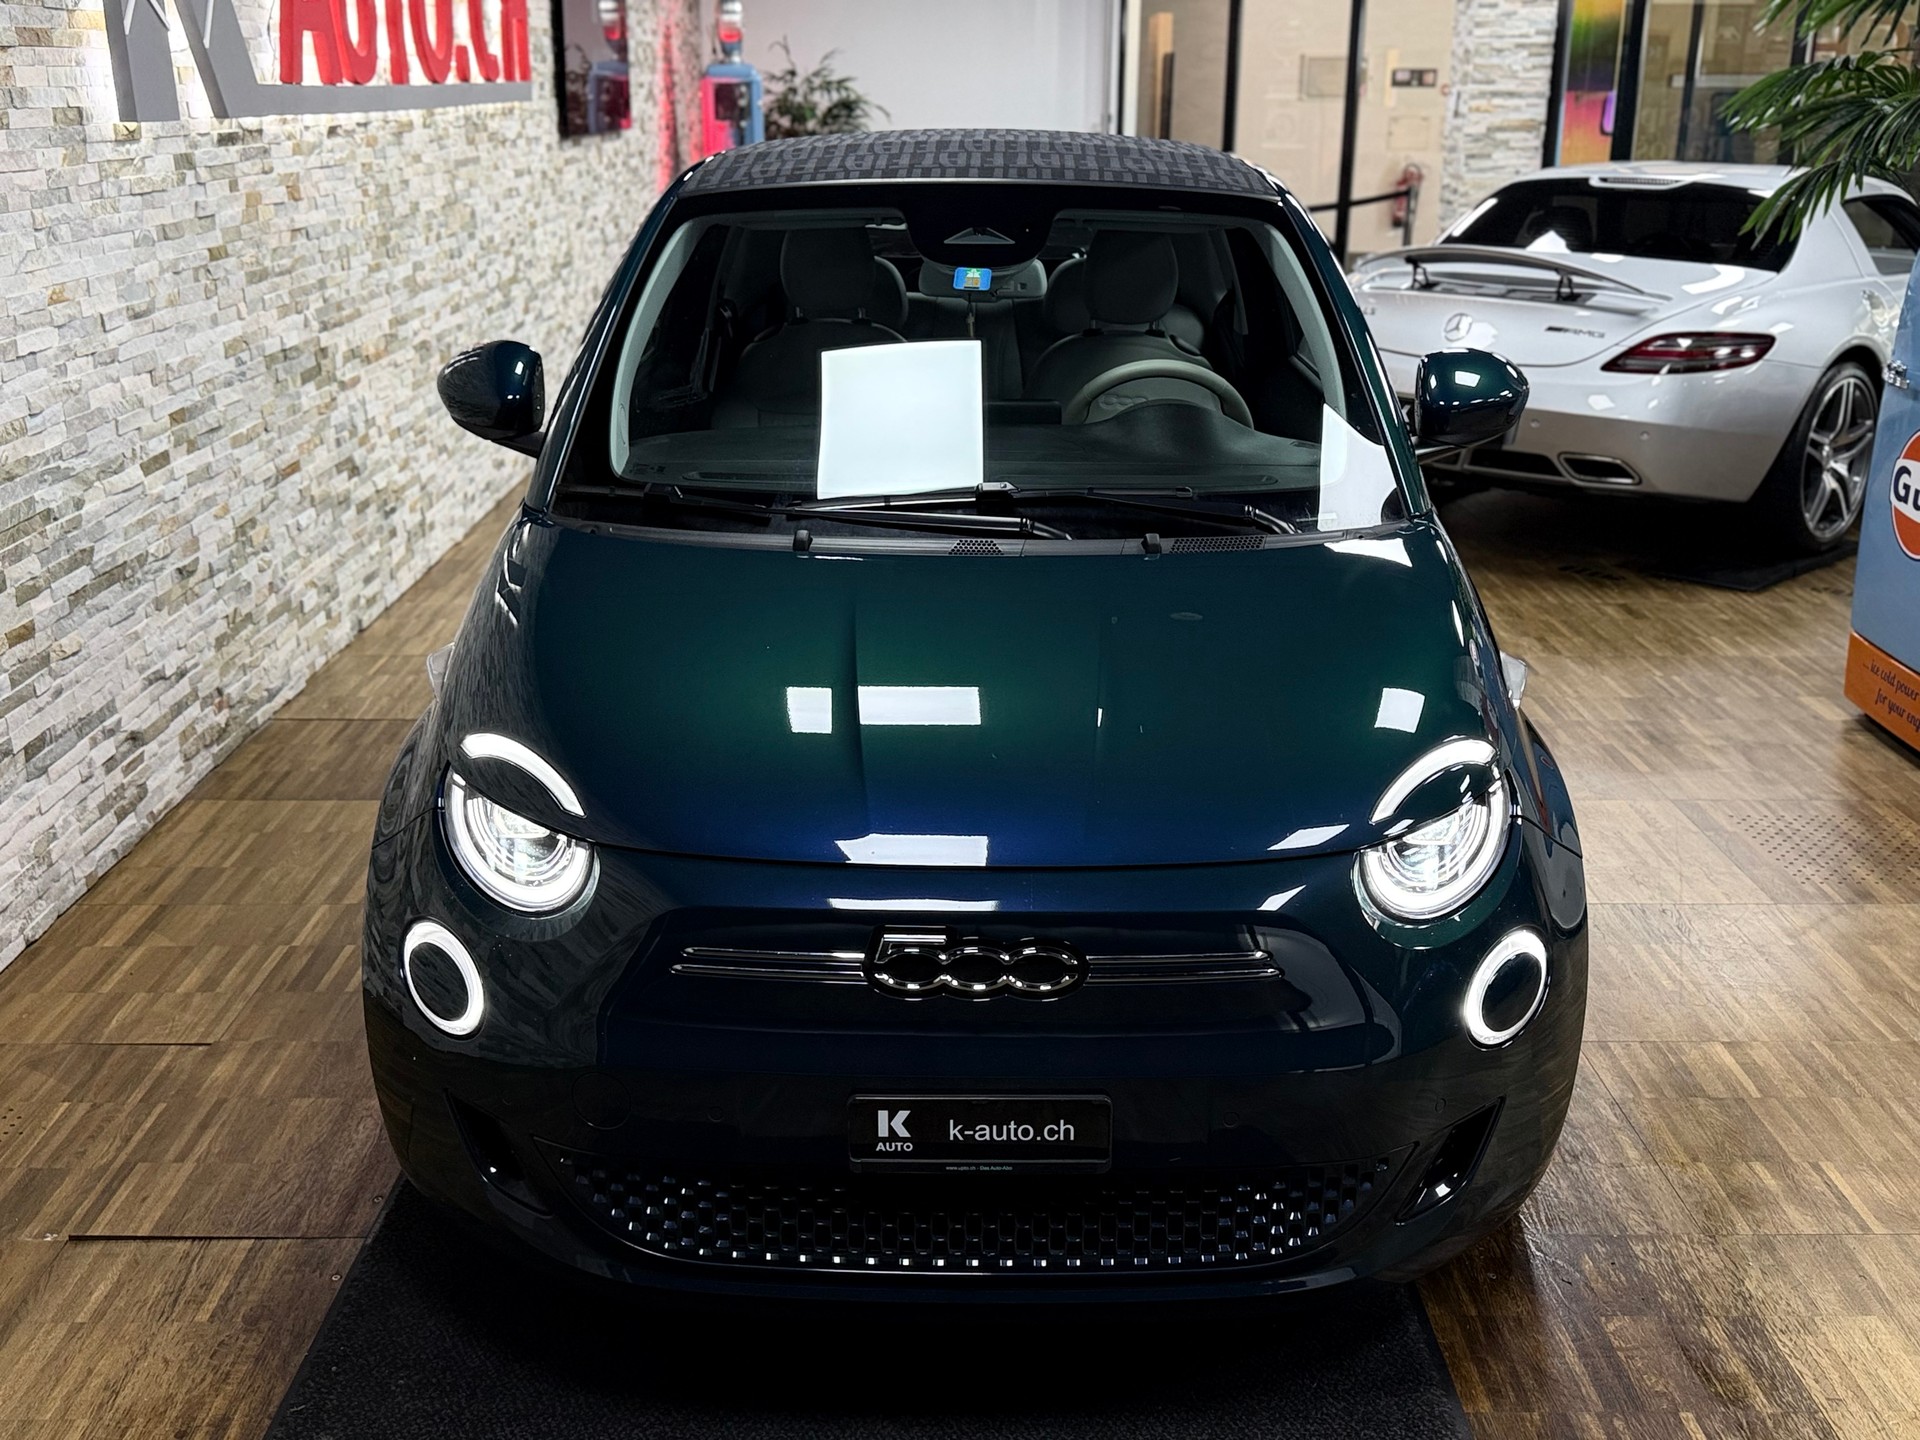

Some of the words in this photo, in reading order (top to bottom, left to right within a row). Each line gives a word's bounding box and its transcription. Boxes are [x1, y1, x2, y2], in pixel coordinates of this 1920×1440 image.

[873, 933, 1079, 992] 500
[877, 1110, 912, 1138] K
[949, 1119, 1075, 1141] k-auto.ch
[875, 1142, 914, 1152] AUTO
